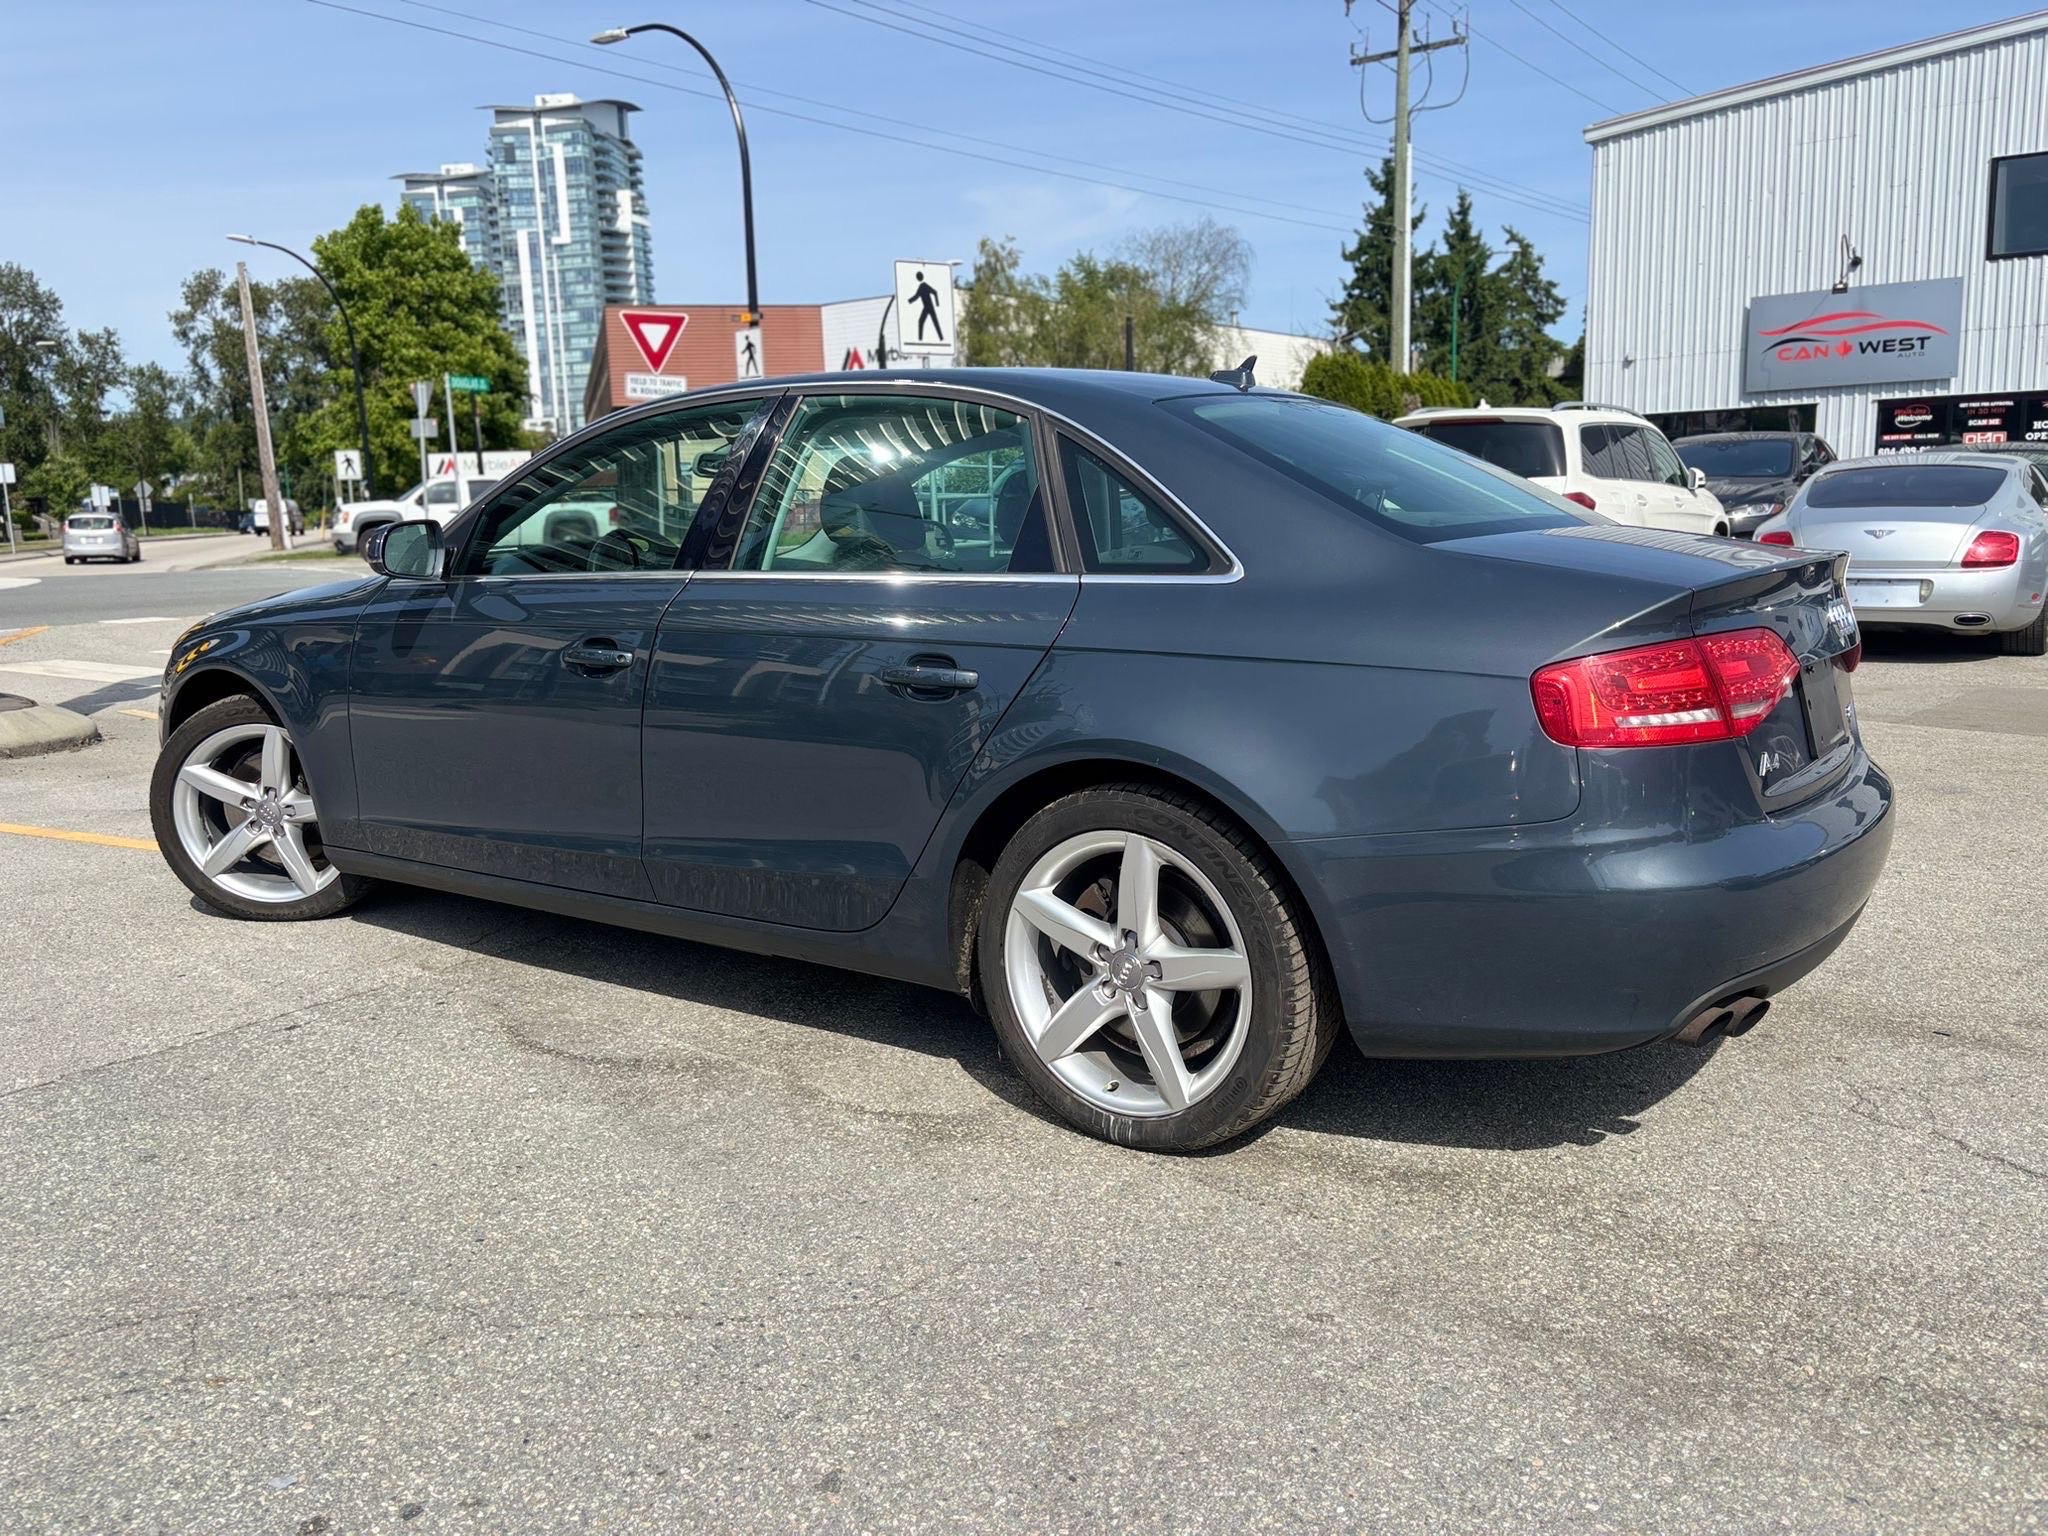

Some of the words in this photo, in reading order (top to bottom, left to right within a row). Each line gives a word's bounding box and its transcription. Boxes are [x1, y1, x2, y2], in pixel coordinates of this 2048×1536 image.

[1776, 344, 1830, 362] CAN
[1858, 335, 1932, 355] WEST
[1897, 351, 1926, 359] AUTO
[1968, 418, 1987, 426] SCAN
[1759, 751, 1780, 777] A4
